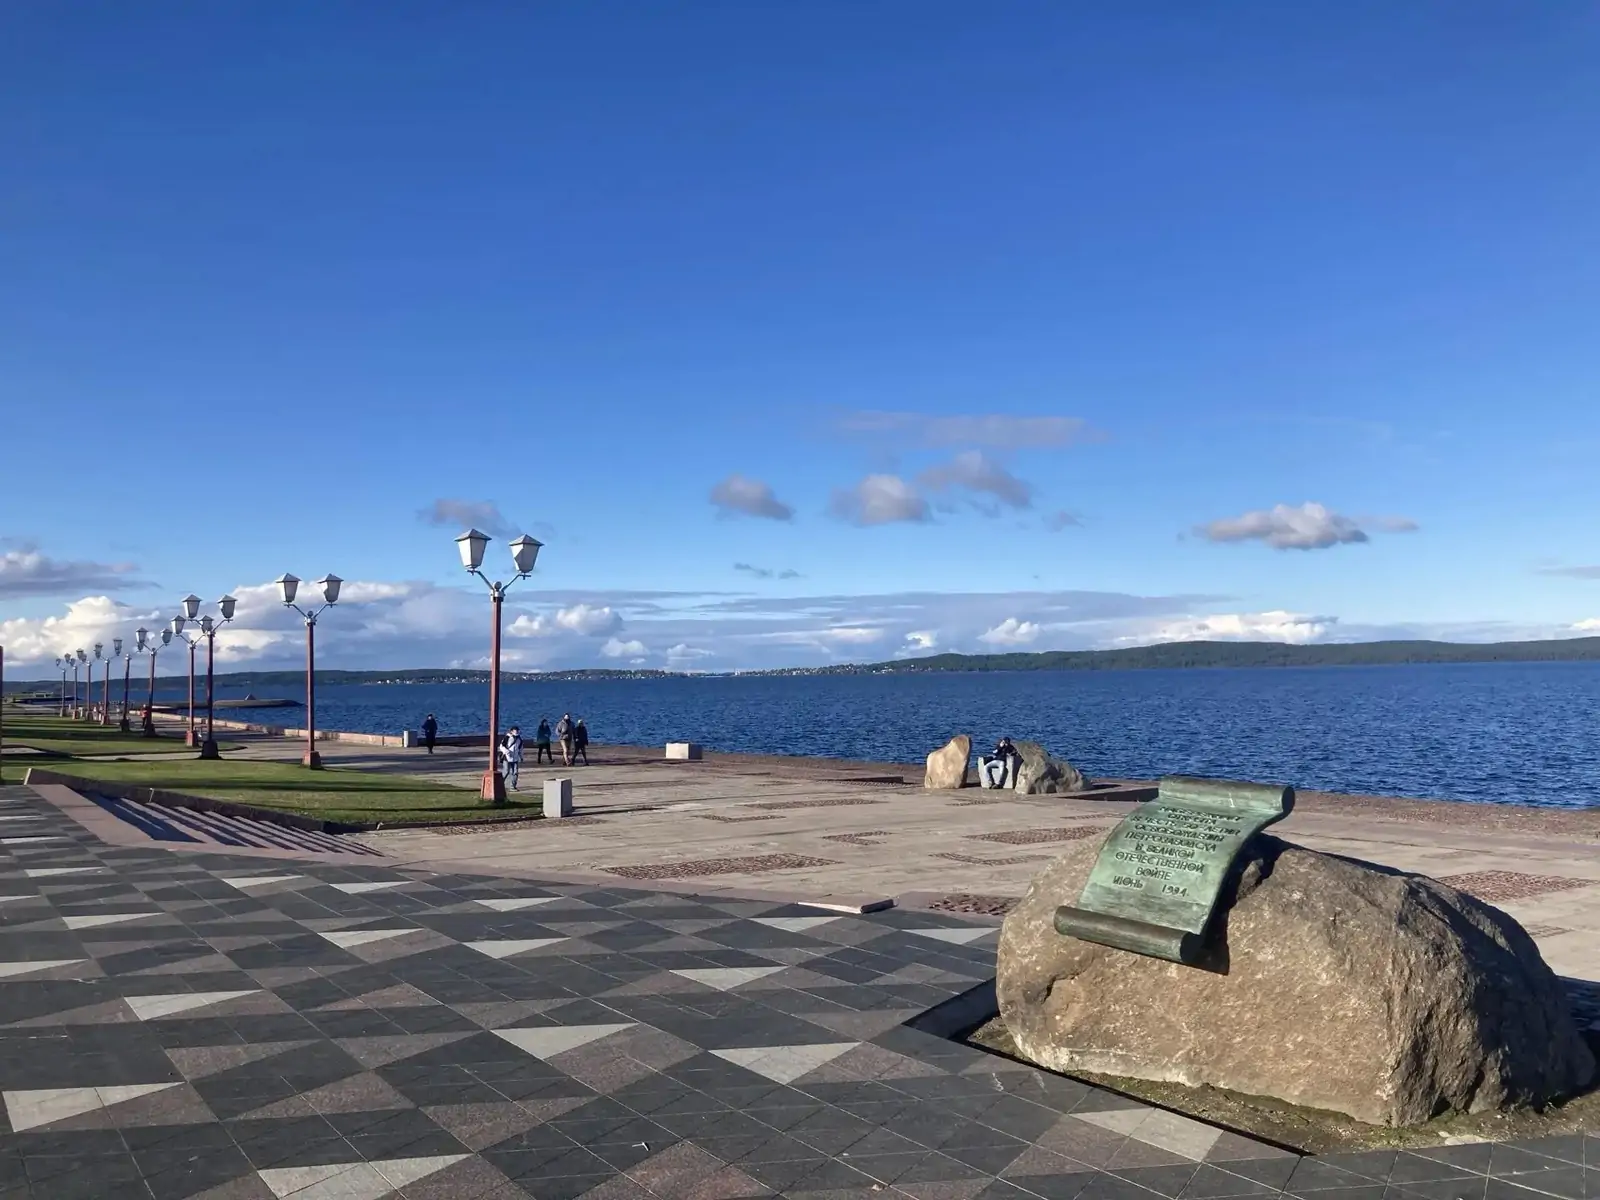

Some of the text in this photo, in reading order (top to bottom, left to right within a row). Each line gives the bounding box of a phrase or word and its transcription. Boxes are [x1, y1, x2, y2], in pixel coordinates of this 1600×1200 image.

[1147, 844, 1195, 858] ВЕЛИКОЙ
[1115, 851, 1205, 873] ОТЕЧЕСТВЕННОЙ
[1136, 867, 1173, 881] ВОЙНЕ
[1113, 875, 1143, 889] ИЮНЬ
